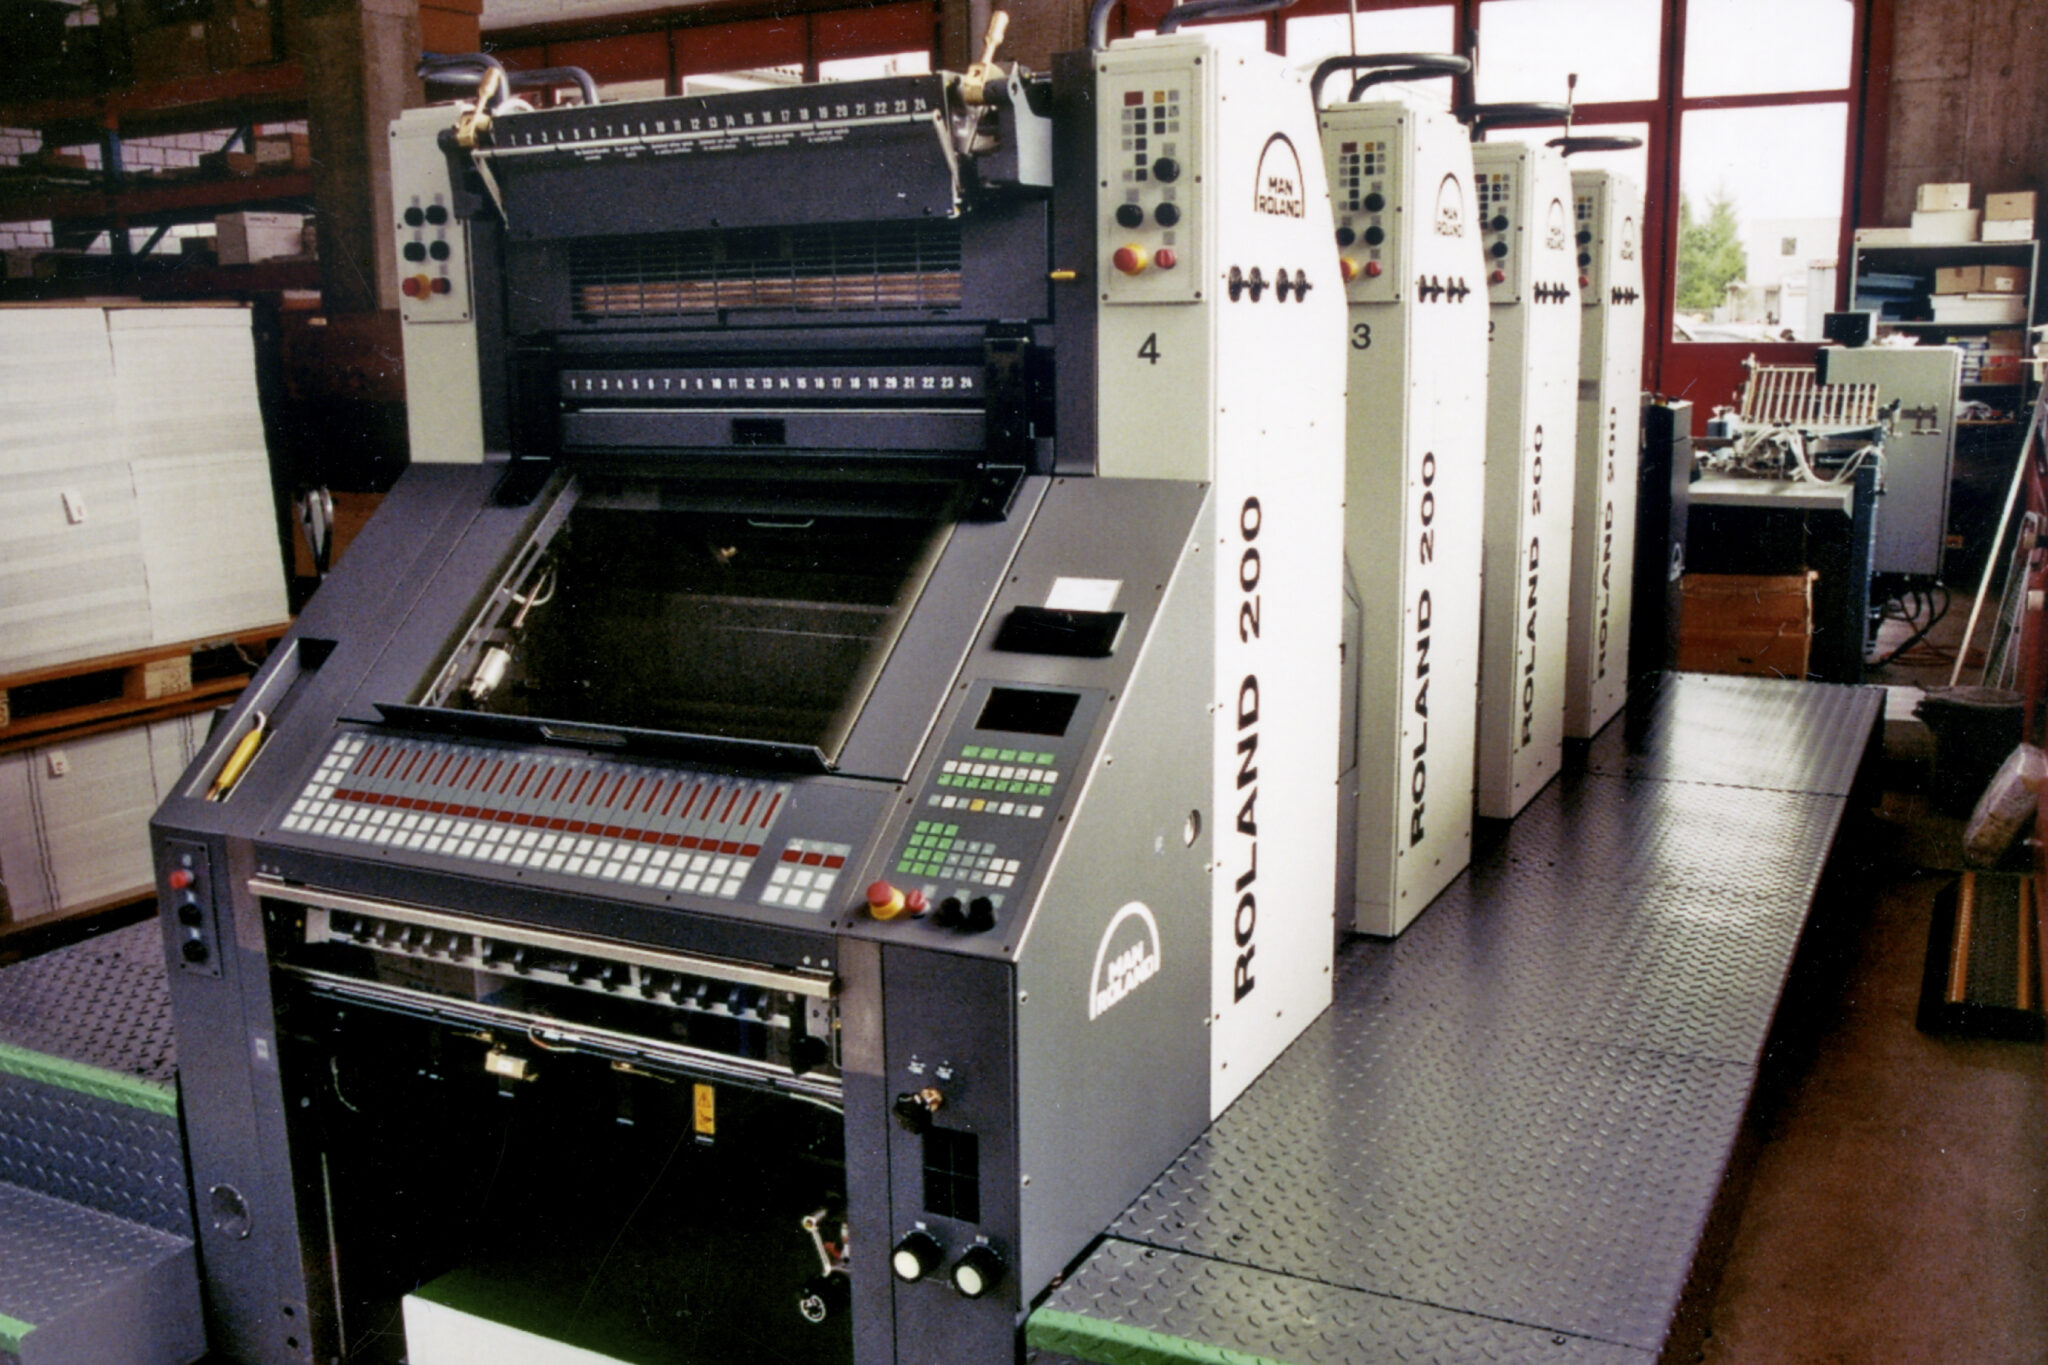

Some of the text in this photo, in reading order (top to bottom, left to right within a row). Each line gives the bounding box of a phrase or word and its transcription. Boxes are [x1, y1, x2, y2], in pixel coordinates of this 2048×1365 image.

[511, 133, 516, 146] 1
[525, 133, 532, 145] 2
[541, 131, 548, 143] 3
[557, 129, 564, 141] 4
[573, 127, 580, 140] 5
[589, 126, 597, 139] 6
[606, 124, 613, 137] 7
[656, 120, 666, 133] 10
[673, 118, 682, 131] 11
[690, 117, 700, 130] 12
[708, 116, 718, 128] 13
[725, 114, 735, 127] 14
[744, 112, 754, 125] 15
[762, 110, 772, 123] 16
[781, 109, 791, 122] 17
[818, 105, 829, 119] 19
[835, 104, 849, 118] 20
[855, 103, 867, 116] 21
[874, 101, 888, 115] 22
[894, 100, 907, 113] 23
[914, 98, 927, 111] 24
[1259, 195, 1301, 218] ROLAND
[1268, 177, 1293, 196] MAN
[1137, 332, 1161, 365] 4
[1351, 322, 1371, 350] 3
[1410, 451, 1436, 848] ROLAND 200
[1521, 536, 1539, 748] ROLAND
[1233, 496, 1262, 1005] ROLAND 200
